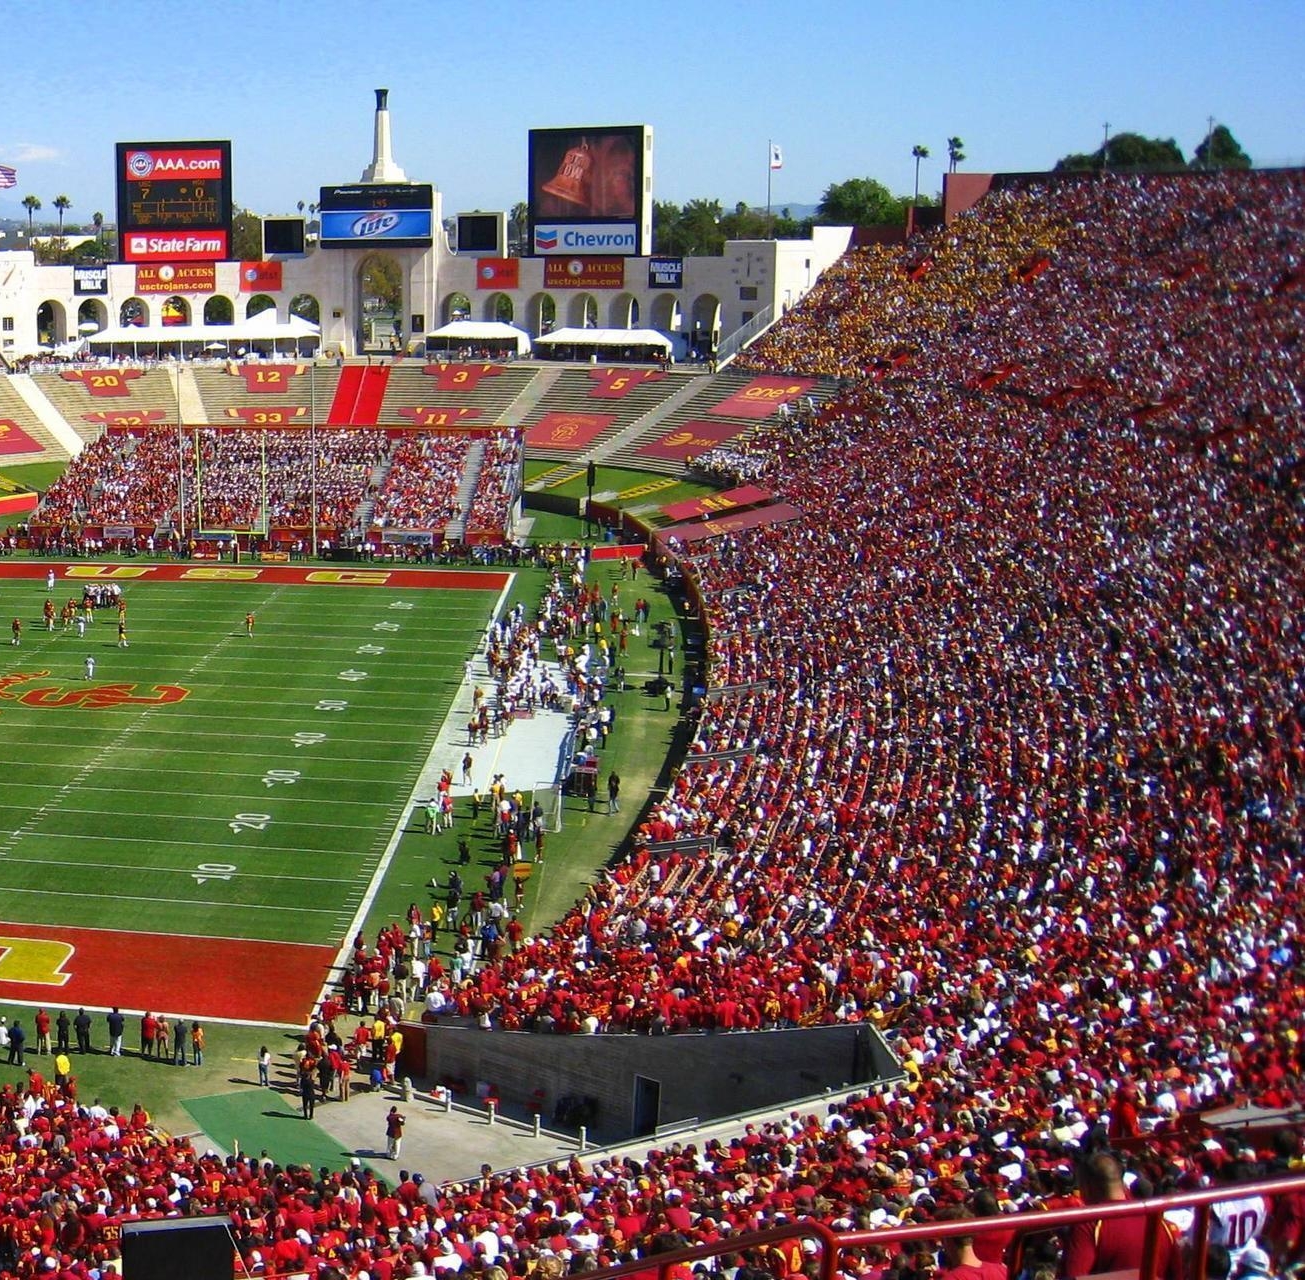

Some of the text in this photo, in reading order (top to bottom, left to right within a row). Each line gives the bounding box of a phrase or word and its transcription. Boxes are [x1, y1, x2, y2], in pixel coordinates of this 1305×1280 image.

[154, 158, 220, 170] AAA.com
[141, 189, 150, 199] 7
[195, 187, 204, 198] 0
[359, 215, 394, 236] Lite
[563, 231, 634, 246] Chevron
[148, 237, 221, 253] State Farm
[138, 268, 214, 278] ALL ACCESS
[546, 262, 622, 273] ALL ACCESS
[650, 262, 682, 273] MUSCLE
[75, 269, 107, 280] MUSCLE
[656, 272, 677, 284] MILK
[81, 279, 102, 290] MILK
[139, 281, 212, 291] usctrojans.com
[547, 277, 621, 287] usctrojans.com
[90, 375, 118, 387] 20
[256, 372, 280, 382] 12
[453, 371, 468, 382] 3
[610, 378, 629, 390] 5
[253, 413, 282, 423] 33
[424, 414, 447, 424] 11
[314, 700, 348, 711] 50
[291, 732, 326, 745] 40
[262, 770, 301, 785] 30
[229, 813, 271, 830] 20
[191, 863, 237, 881] 10
[212, 1180, 221, 1194] 8
[103, 1226, 118, 1241] 55
[1228, 1209, 1258, 1248] 10
